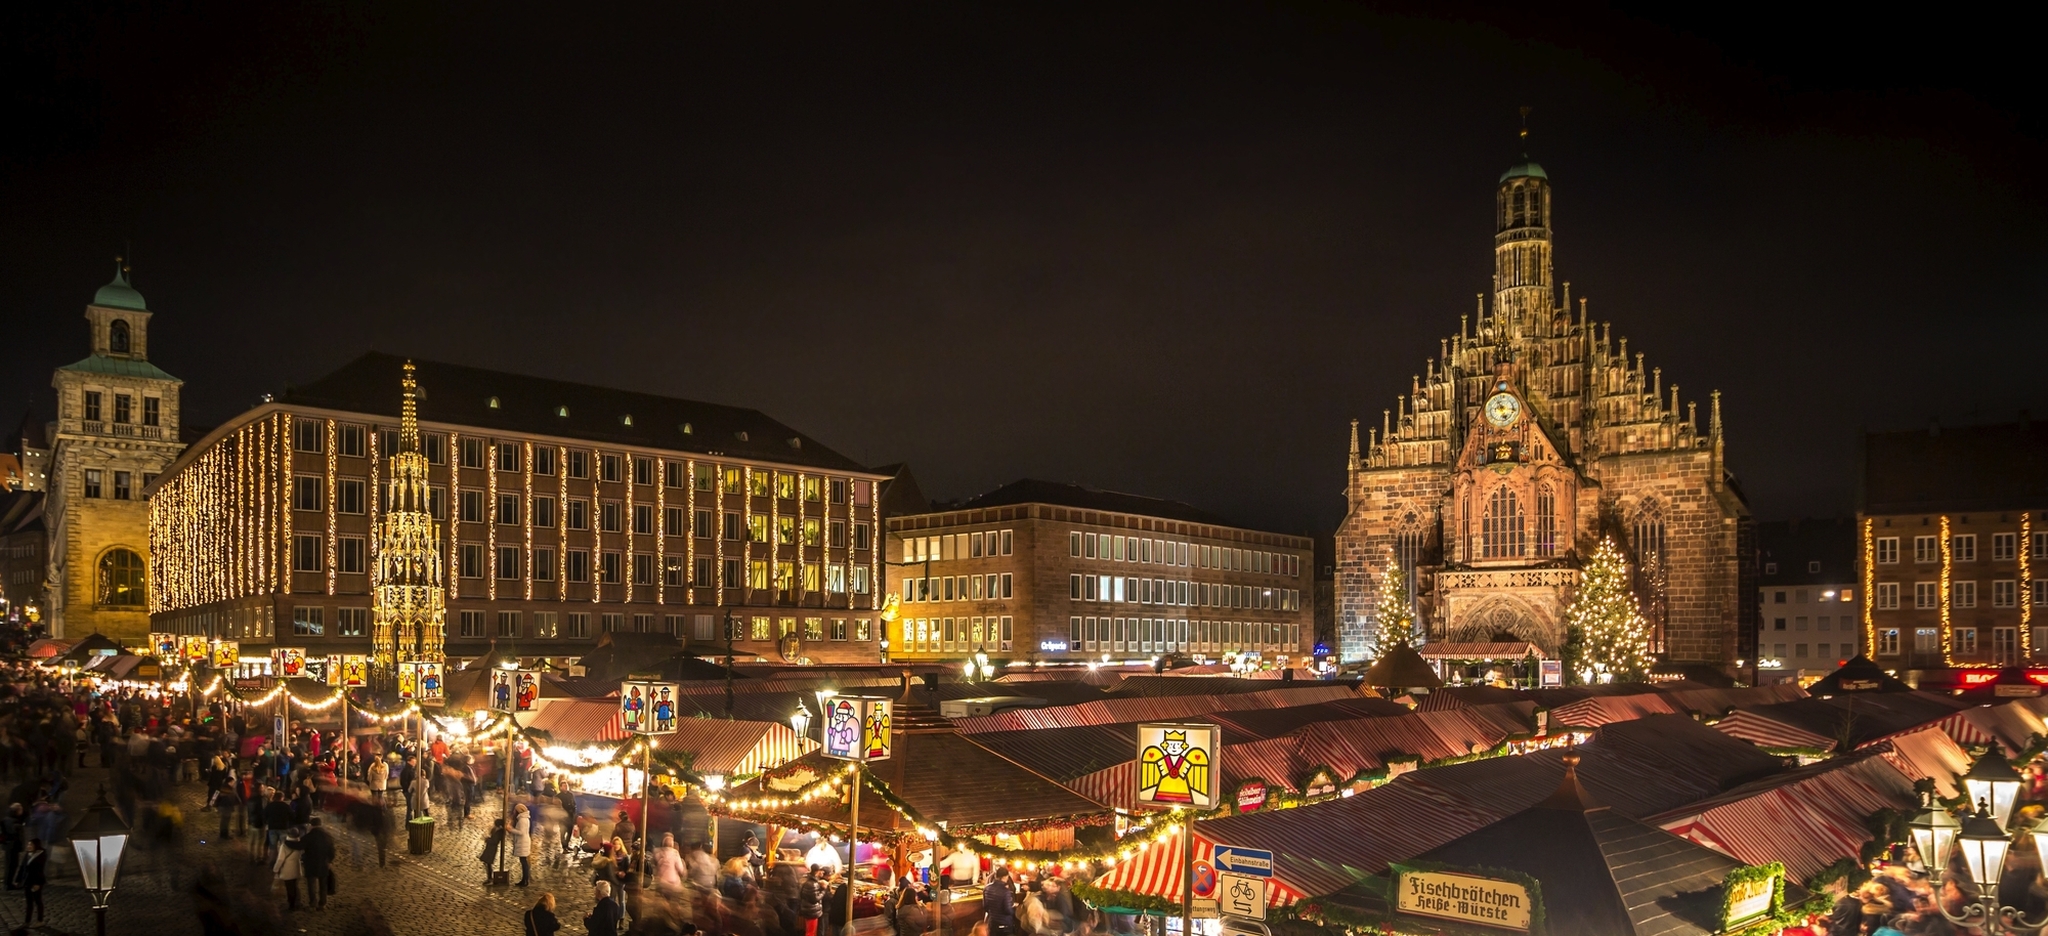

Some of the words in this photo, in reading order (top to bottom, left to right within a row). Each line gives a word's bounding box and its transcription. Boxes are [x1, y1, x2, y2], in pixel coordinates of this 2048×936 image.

[1230, 856, 1269, 868] Einbahnstraße
[1409, 876, 1521, 909] Fischbrötchen
[1415, 895, 1450, 912] Heiße
[1457, 900, 1508, 921] Würste
